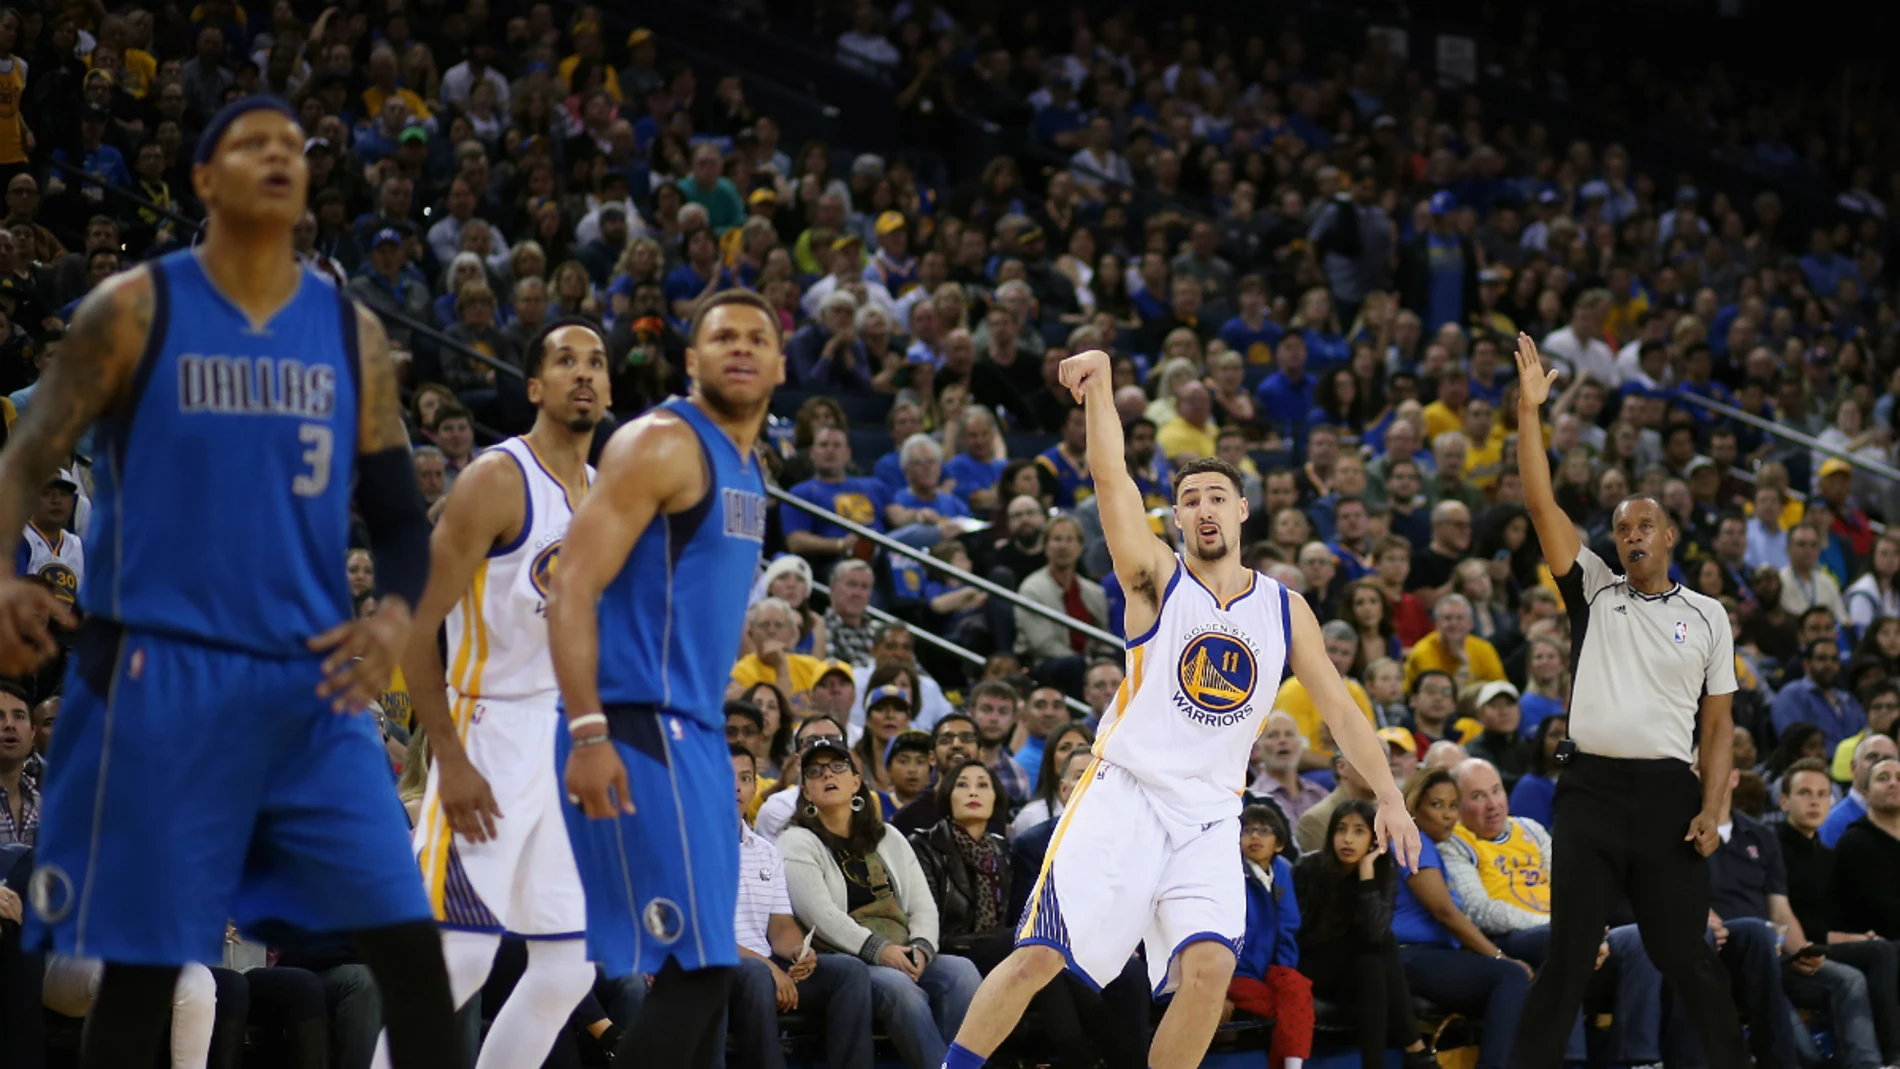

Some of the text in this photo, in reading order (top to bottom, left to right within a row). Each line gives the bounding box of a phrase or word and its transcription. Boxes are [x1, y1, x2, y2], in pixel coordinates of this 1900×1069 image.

[177, 353, 336, 420] DALLAS
[292, 423, 334, 497] 3
[56, 570, 76, 589] 30
[1184, 623, 1261, 656] GOLDEN STATE
[1221, 651, 1240, 674] 11
[1172, 690, 1254, 727] WARRIORS
